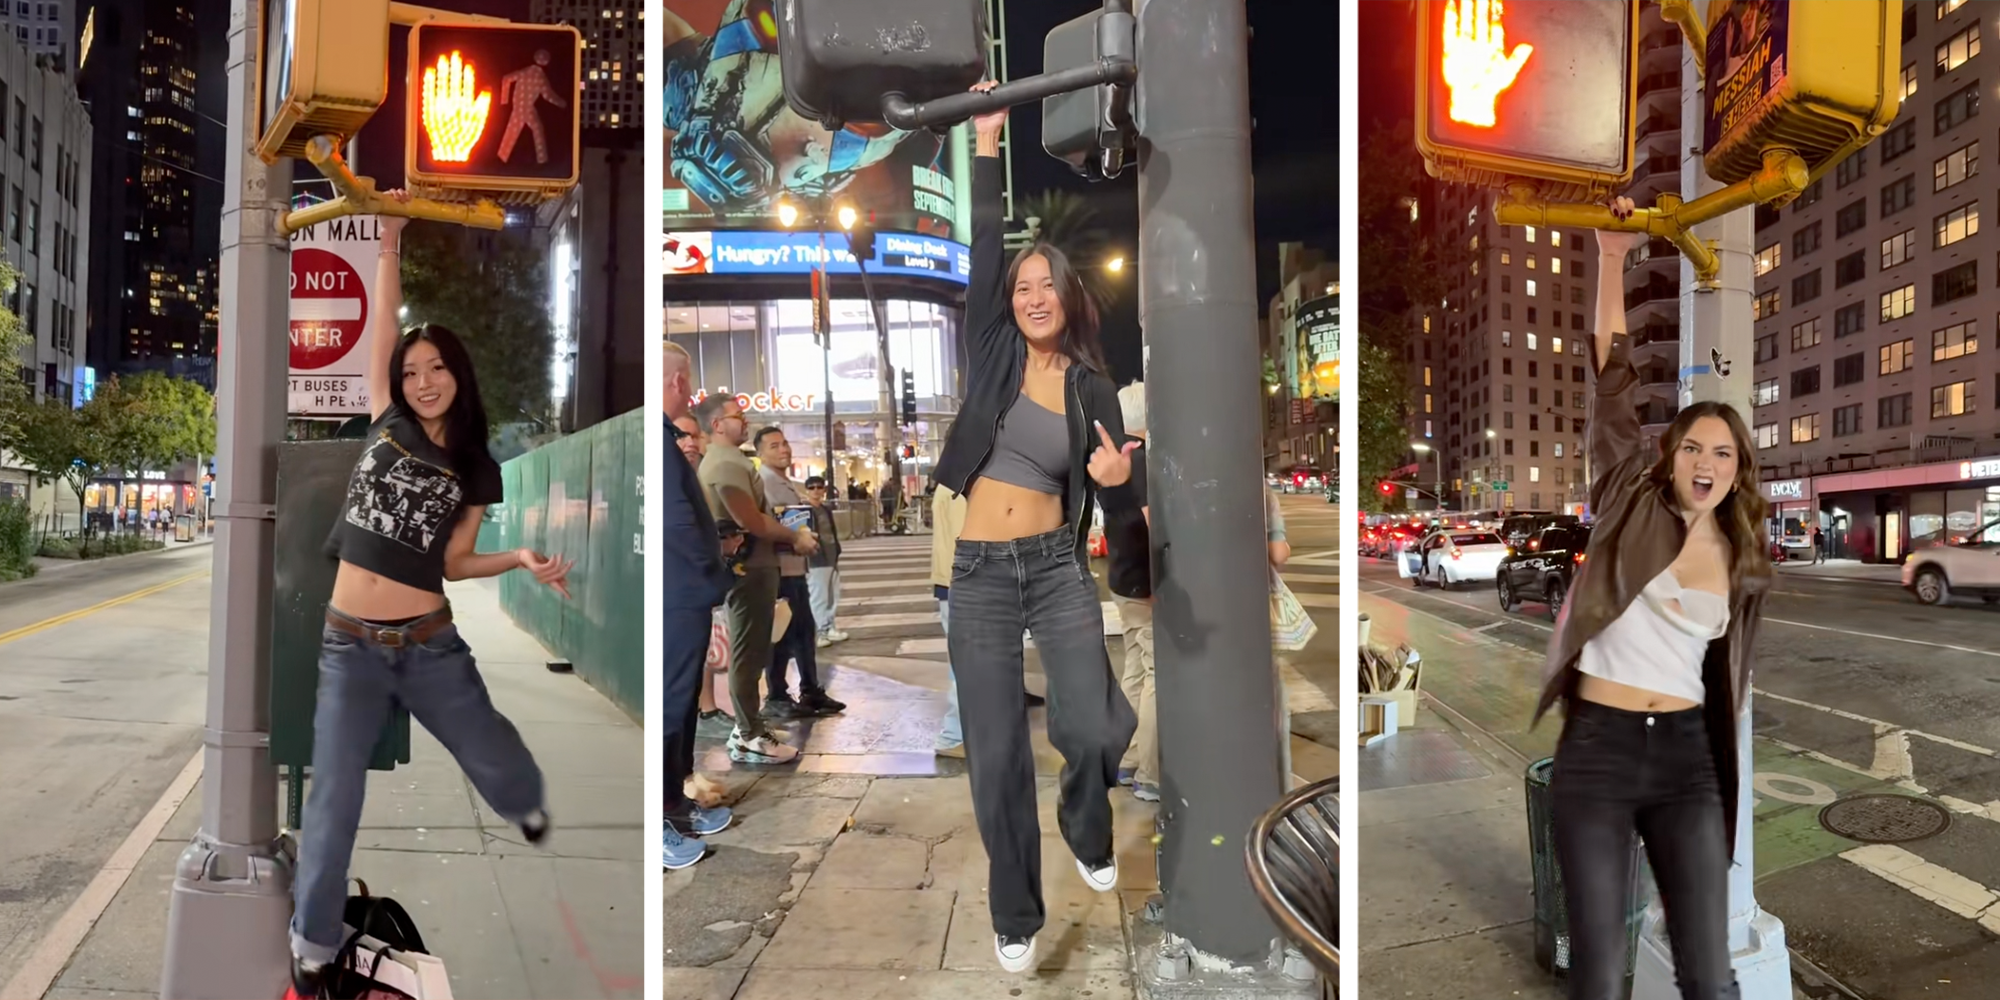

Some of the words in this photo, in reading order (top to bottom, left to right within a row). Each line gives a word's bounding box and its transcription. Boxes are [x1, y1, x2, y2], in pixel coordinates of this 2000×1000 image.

[1712, 36, 1771, 120] MESSIAH
[912, 164, 942, 195] BREAK
[328, 219, 382, 242] MALL
[716, 245, 791, 266] Hungry?
[793, 244, 831, 263] This
[832, 248, 858, 263] wa
[904, 254, 928, 268] Level
[305, 271, 349, 291] NOT
[304, 380, 348, 392] BUSES
[718, 386, 815, 411] ocker
